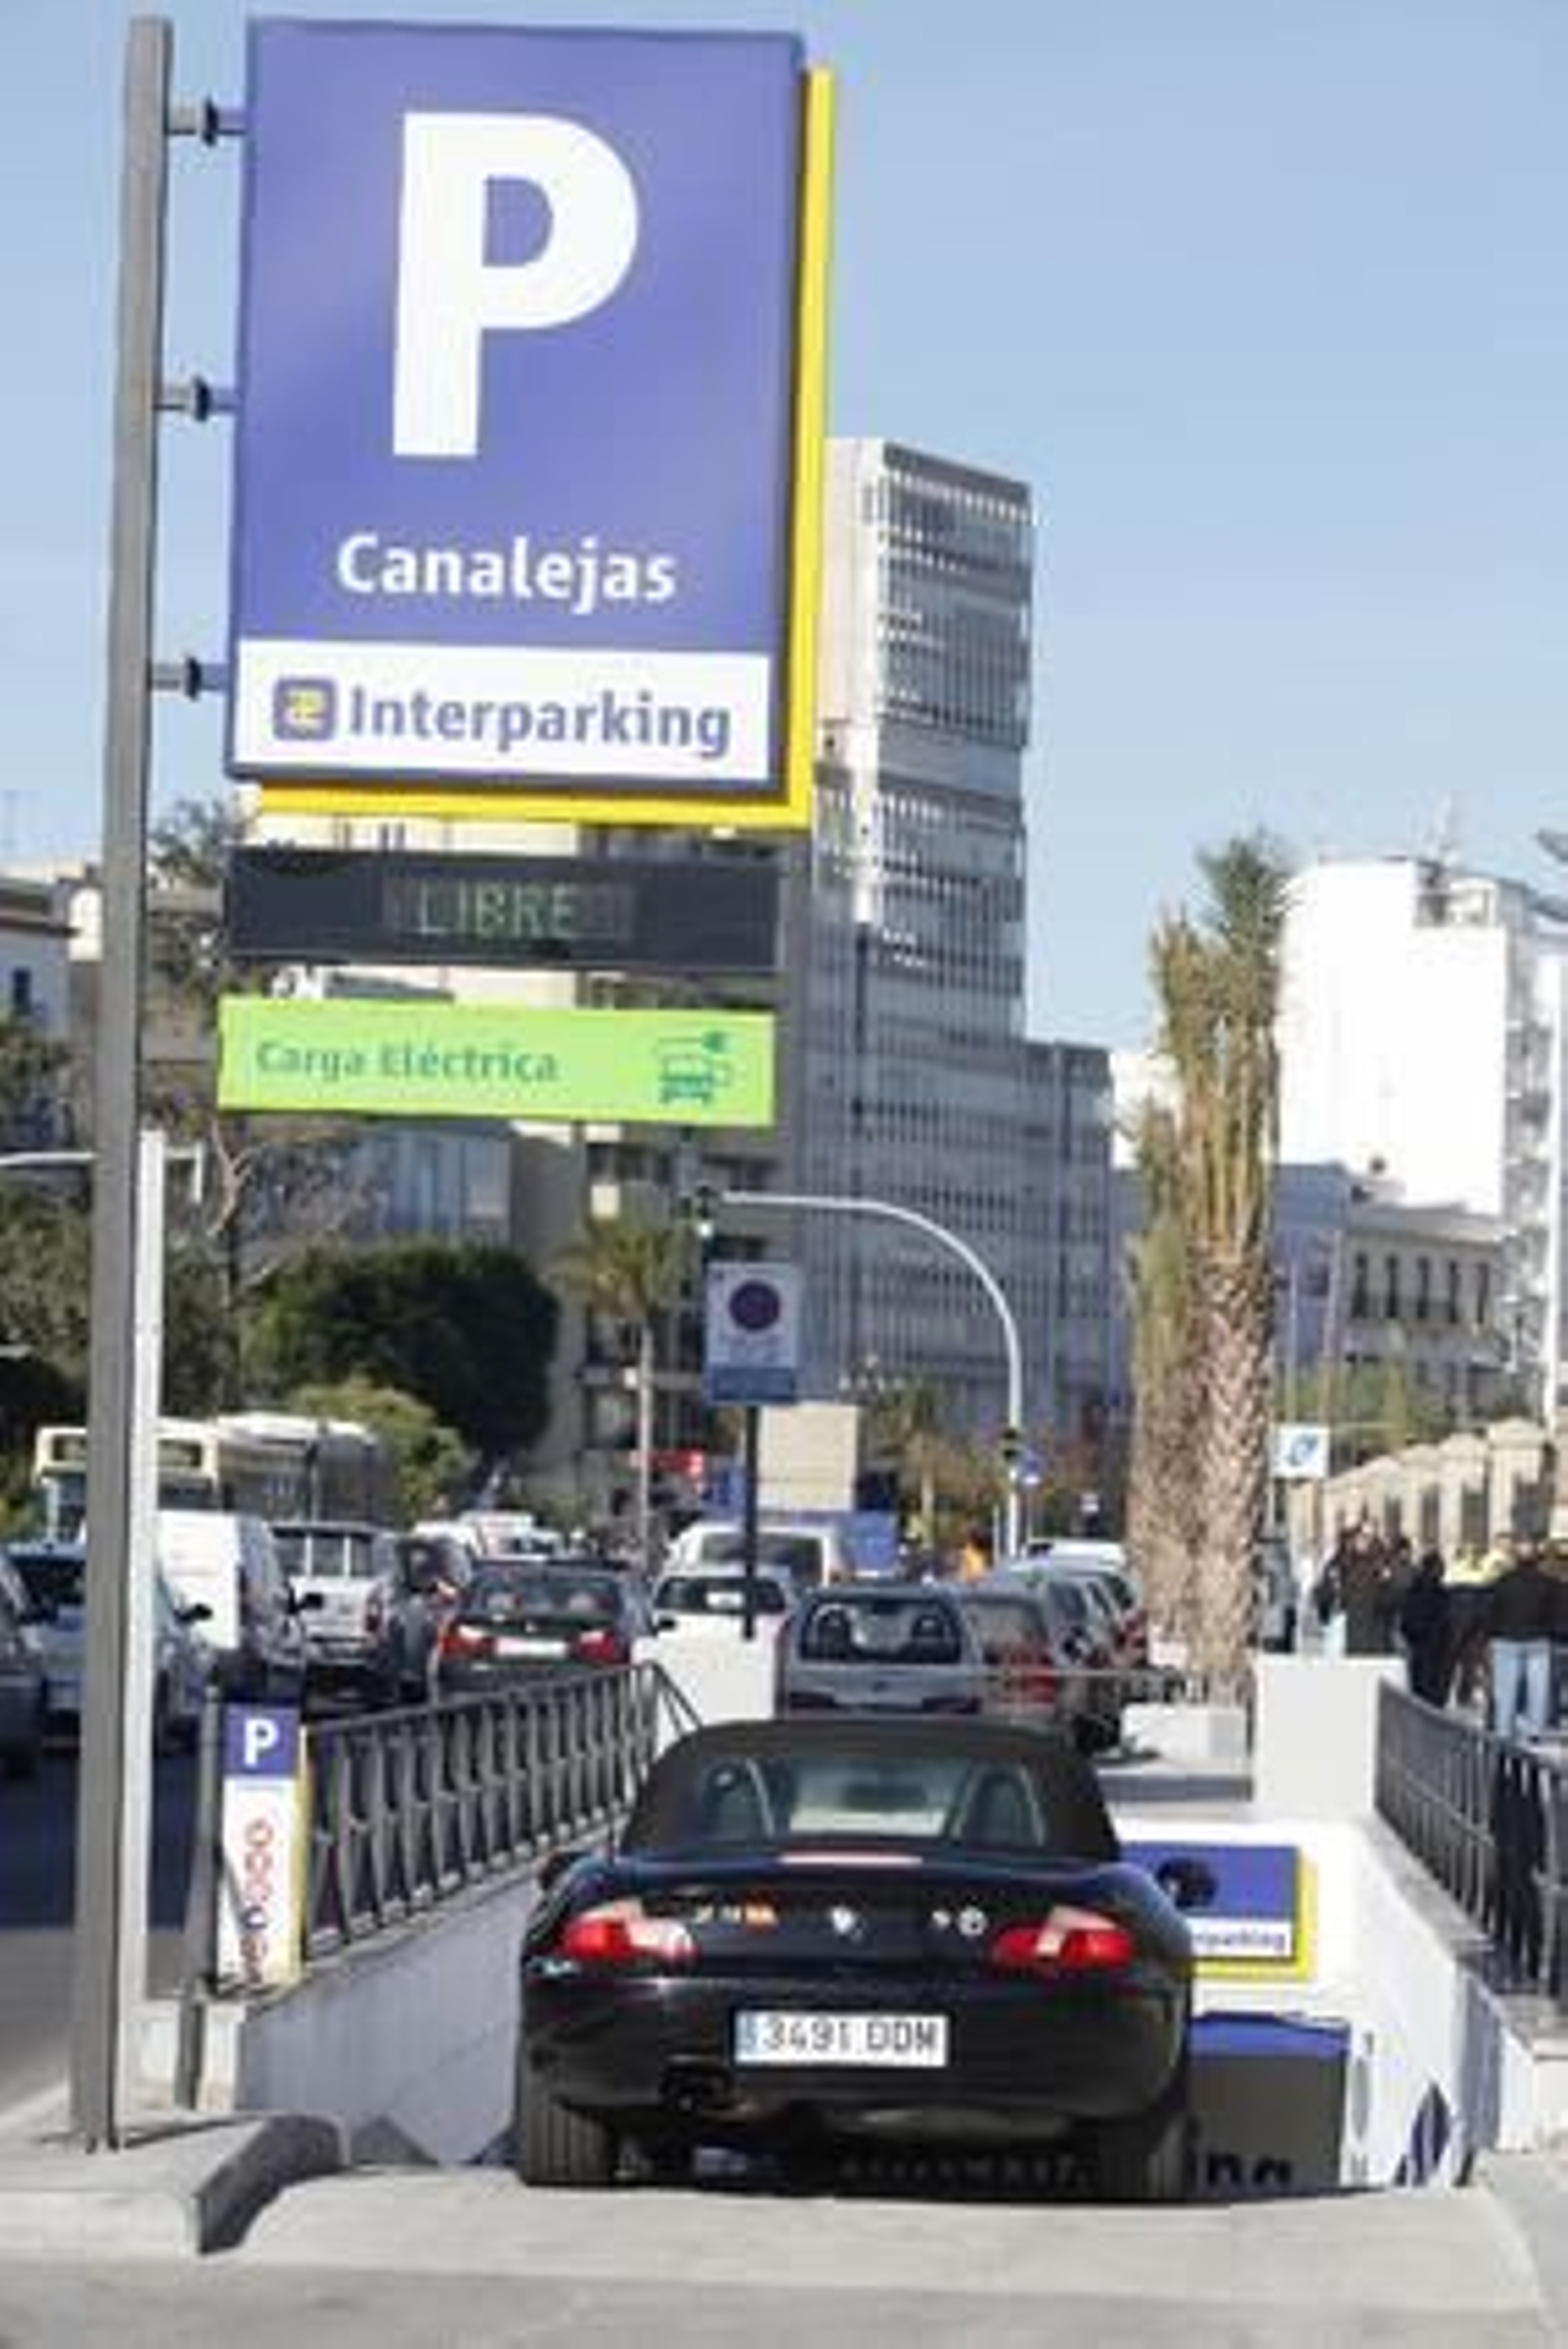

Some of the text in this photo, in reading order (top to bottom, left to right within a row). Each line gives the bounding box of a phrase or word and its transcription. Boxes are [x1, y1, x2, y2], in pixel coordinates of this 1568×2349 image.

[393, 111, 640, 458] P
[337, 533, 678, 616] Canalejas
[349, 685, 732, 759] Interparking
[419, 880, 576, 939] LIBRE
[257, 1037, 559, 1083] Carga Eléctrica
[243, 1718, 279, 1767] P
